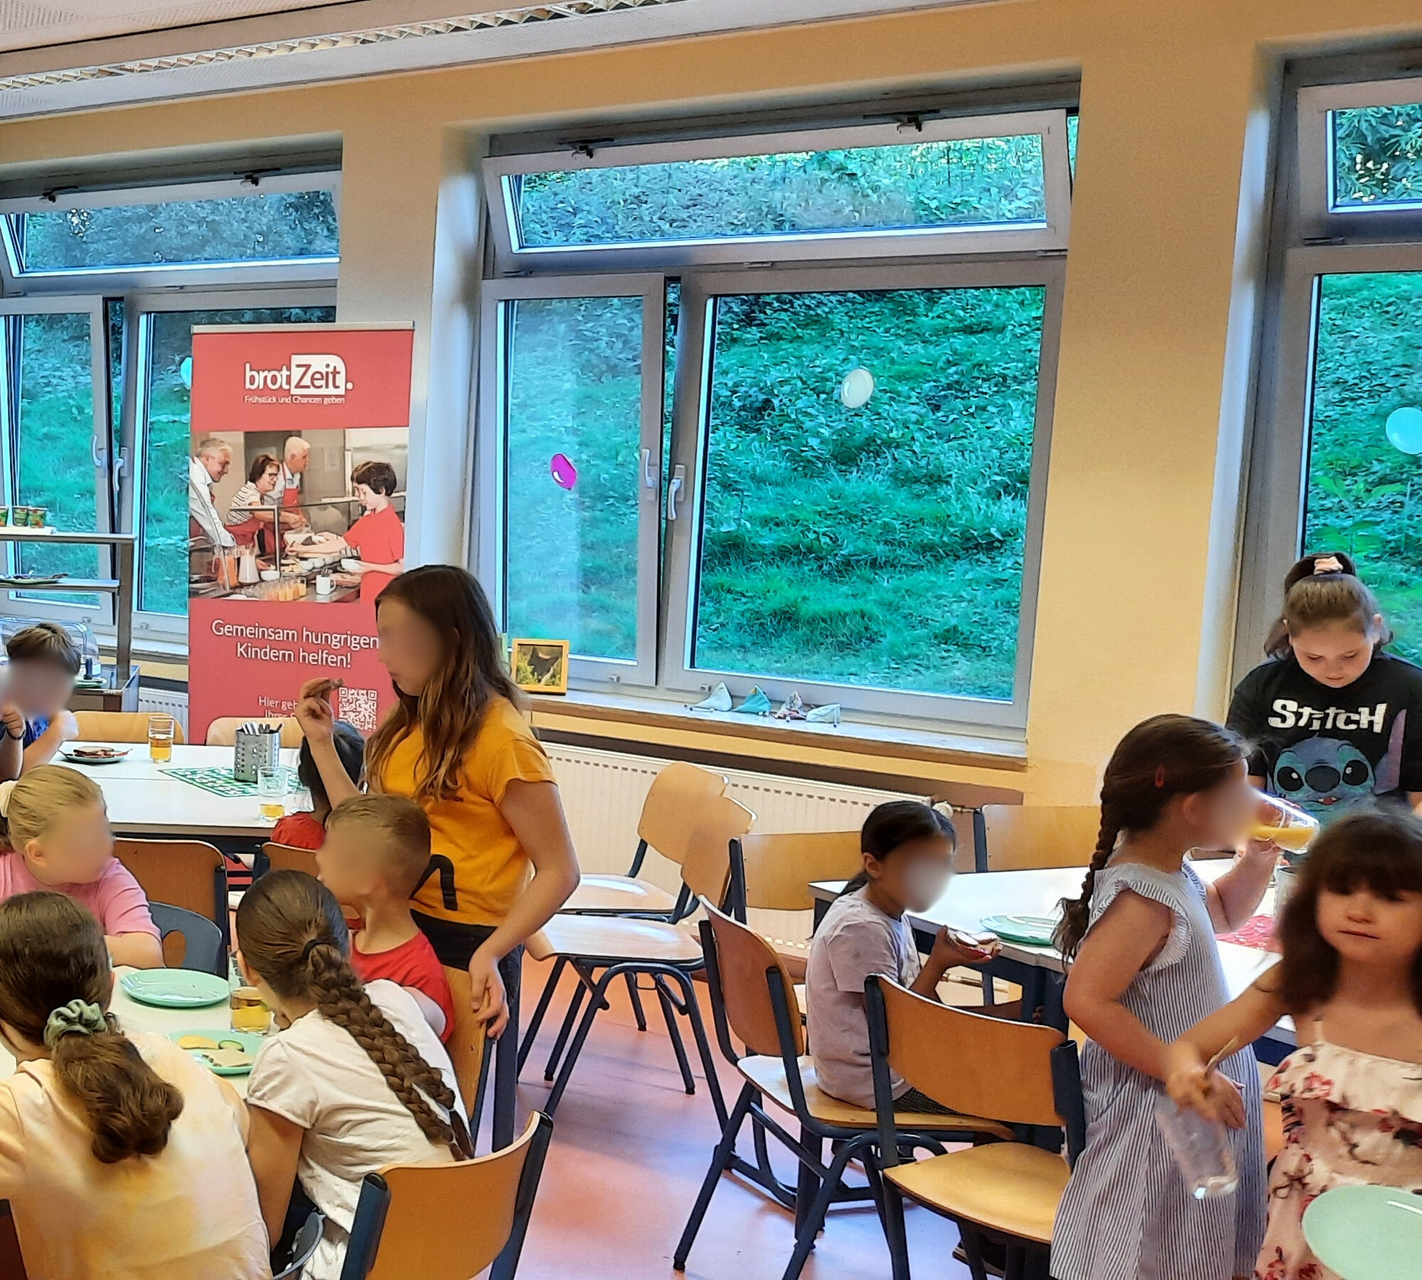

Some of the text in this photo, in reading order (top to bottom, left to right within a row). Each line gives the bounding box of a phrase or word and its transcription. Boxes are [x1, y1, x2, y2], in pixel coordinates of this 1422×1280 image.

[244, 395, 345, 407] Frühstück und Chancen geben
[212, 619, 379, 651] Gemeinsam hungrigen
[237, 641, 351, 669] Kindern helfen!
[258, 696, 279, 708] Hier
